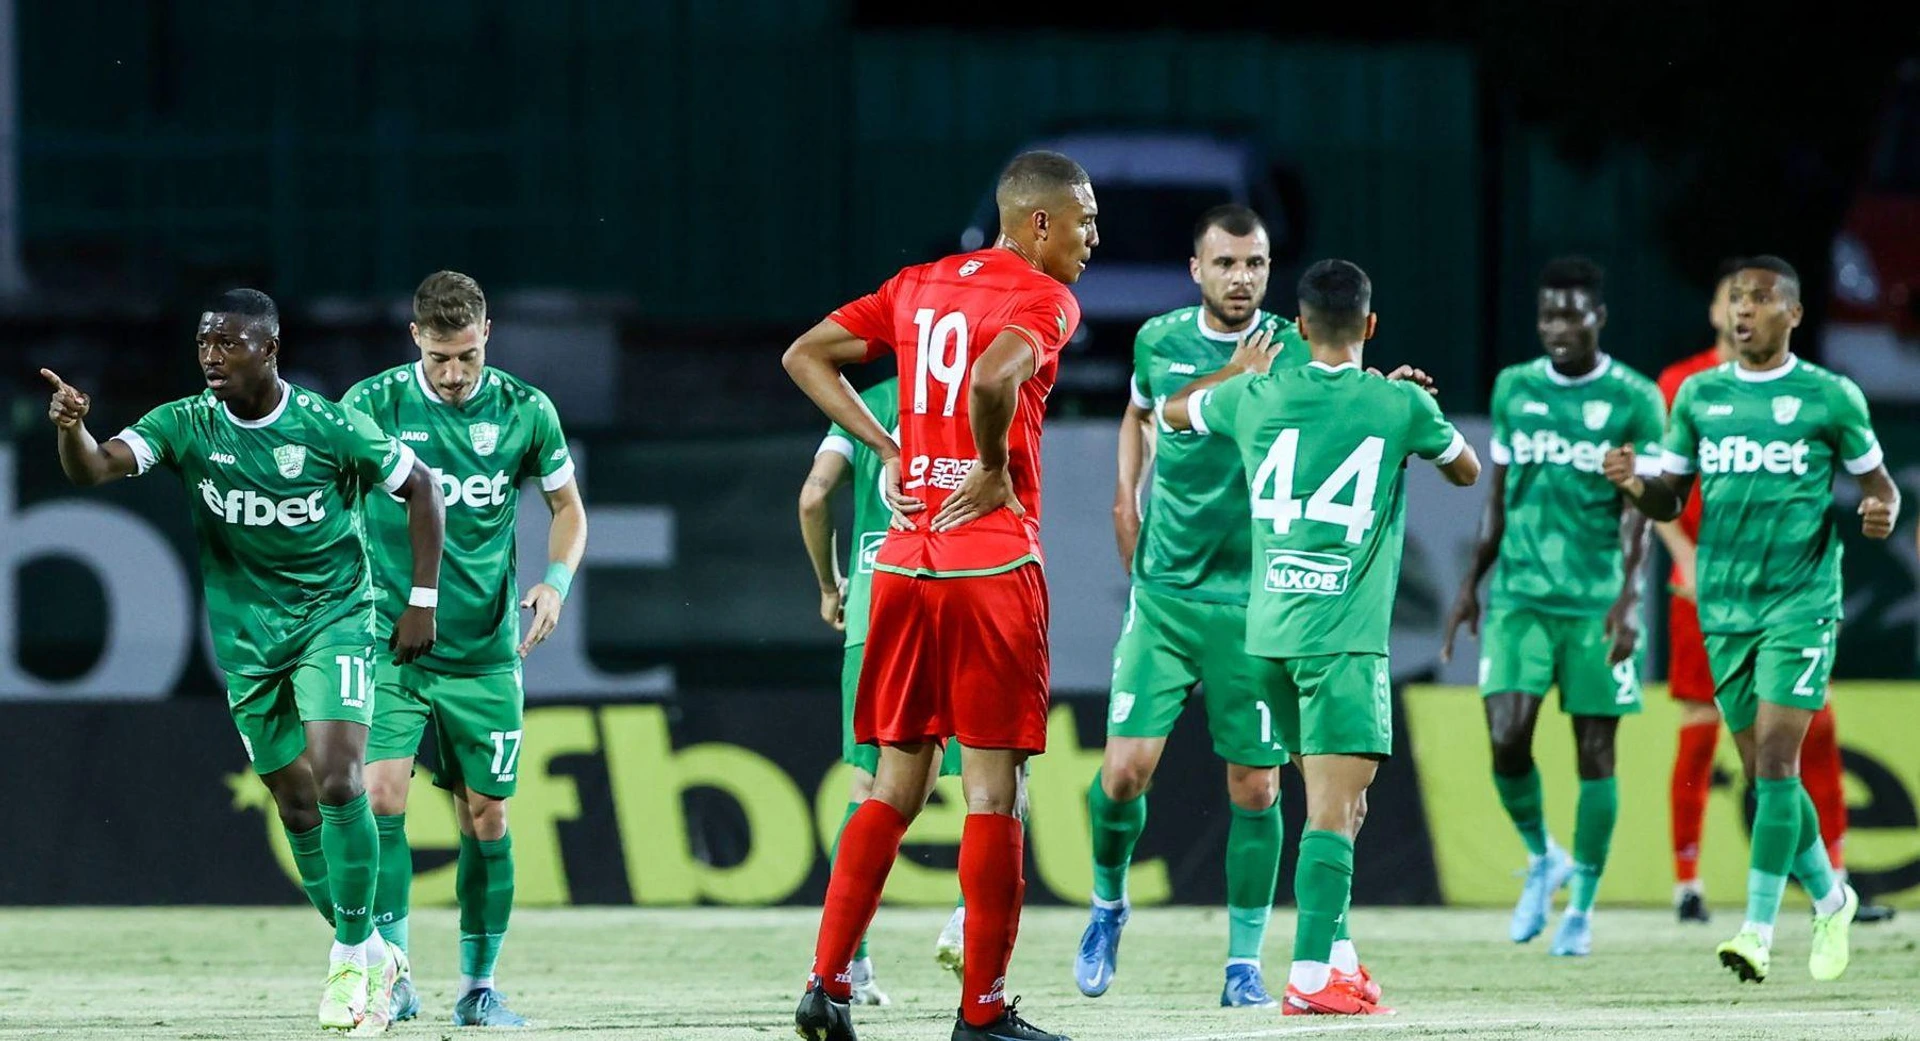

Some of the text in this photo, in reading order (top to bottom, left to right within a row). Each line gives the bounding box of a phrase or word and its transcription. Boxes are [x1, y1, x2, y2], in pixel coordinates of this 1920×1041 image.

[913, 308, 968, 417] 19
[208, 451, 236, 465] JAKO
[400, 431, 429, 442] JAKO
[1698, 436, 1809, 475] efbet
[198, 478, 326, 527] efbet
[1251, 428, 1385, 545] 44
[335, 655, 366, 700] 11
[1256, 700, 1277, 743] 1
[490, 729, 522, 774] 17
